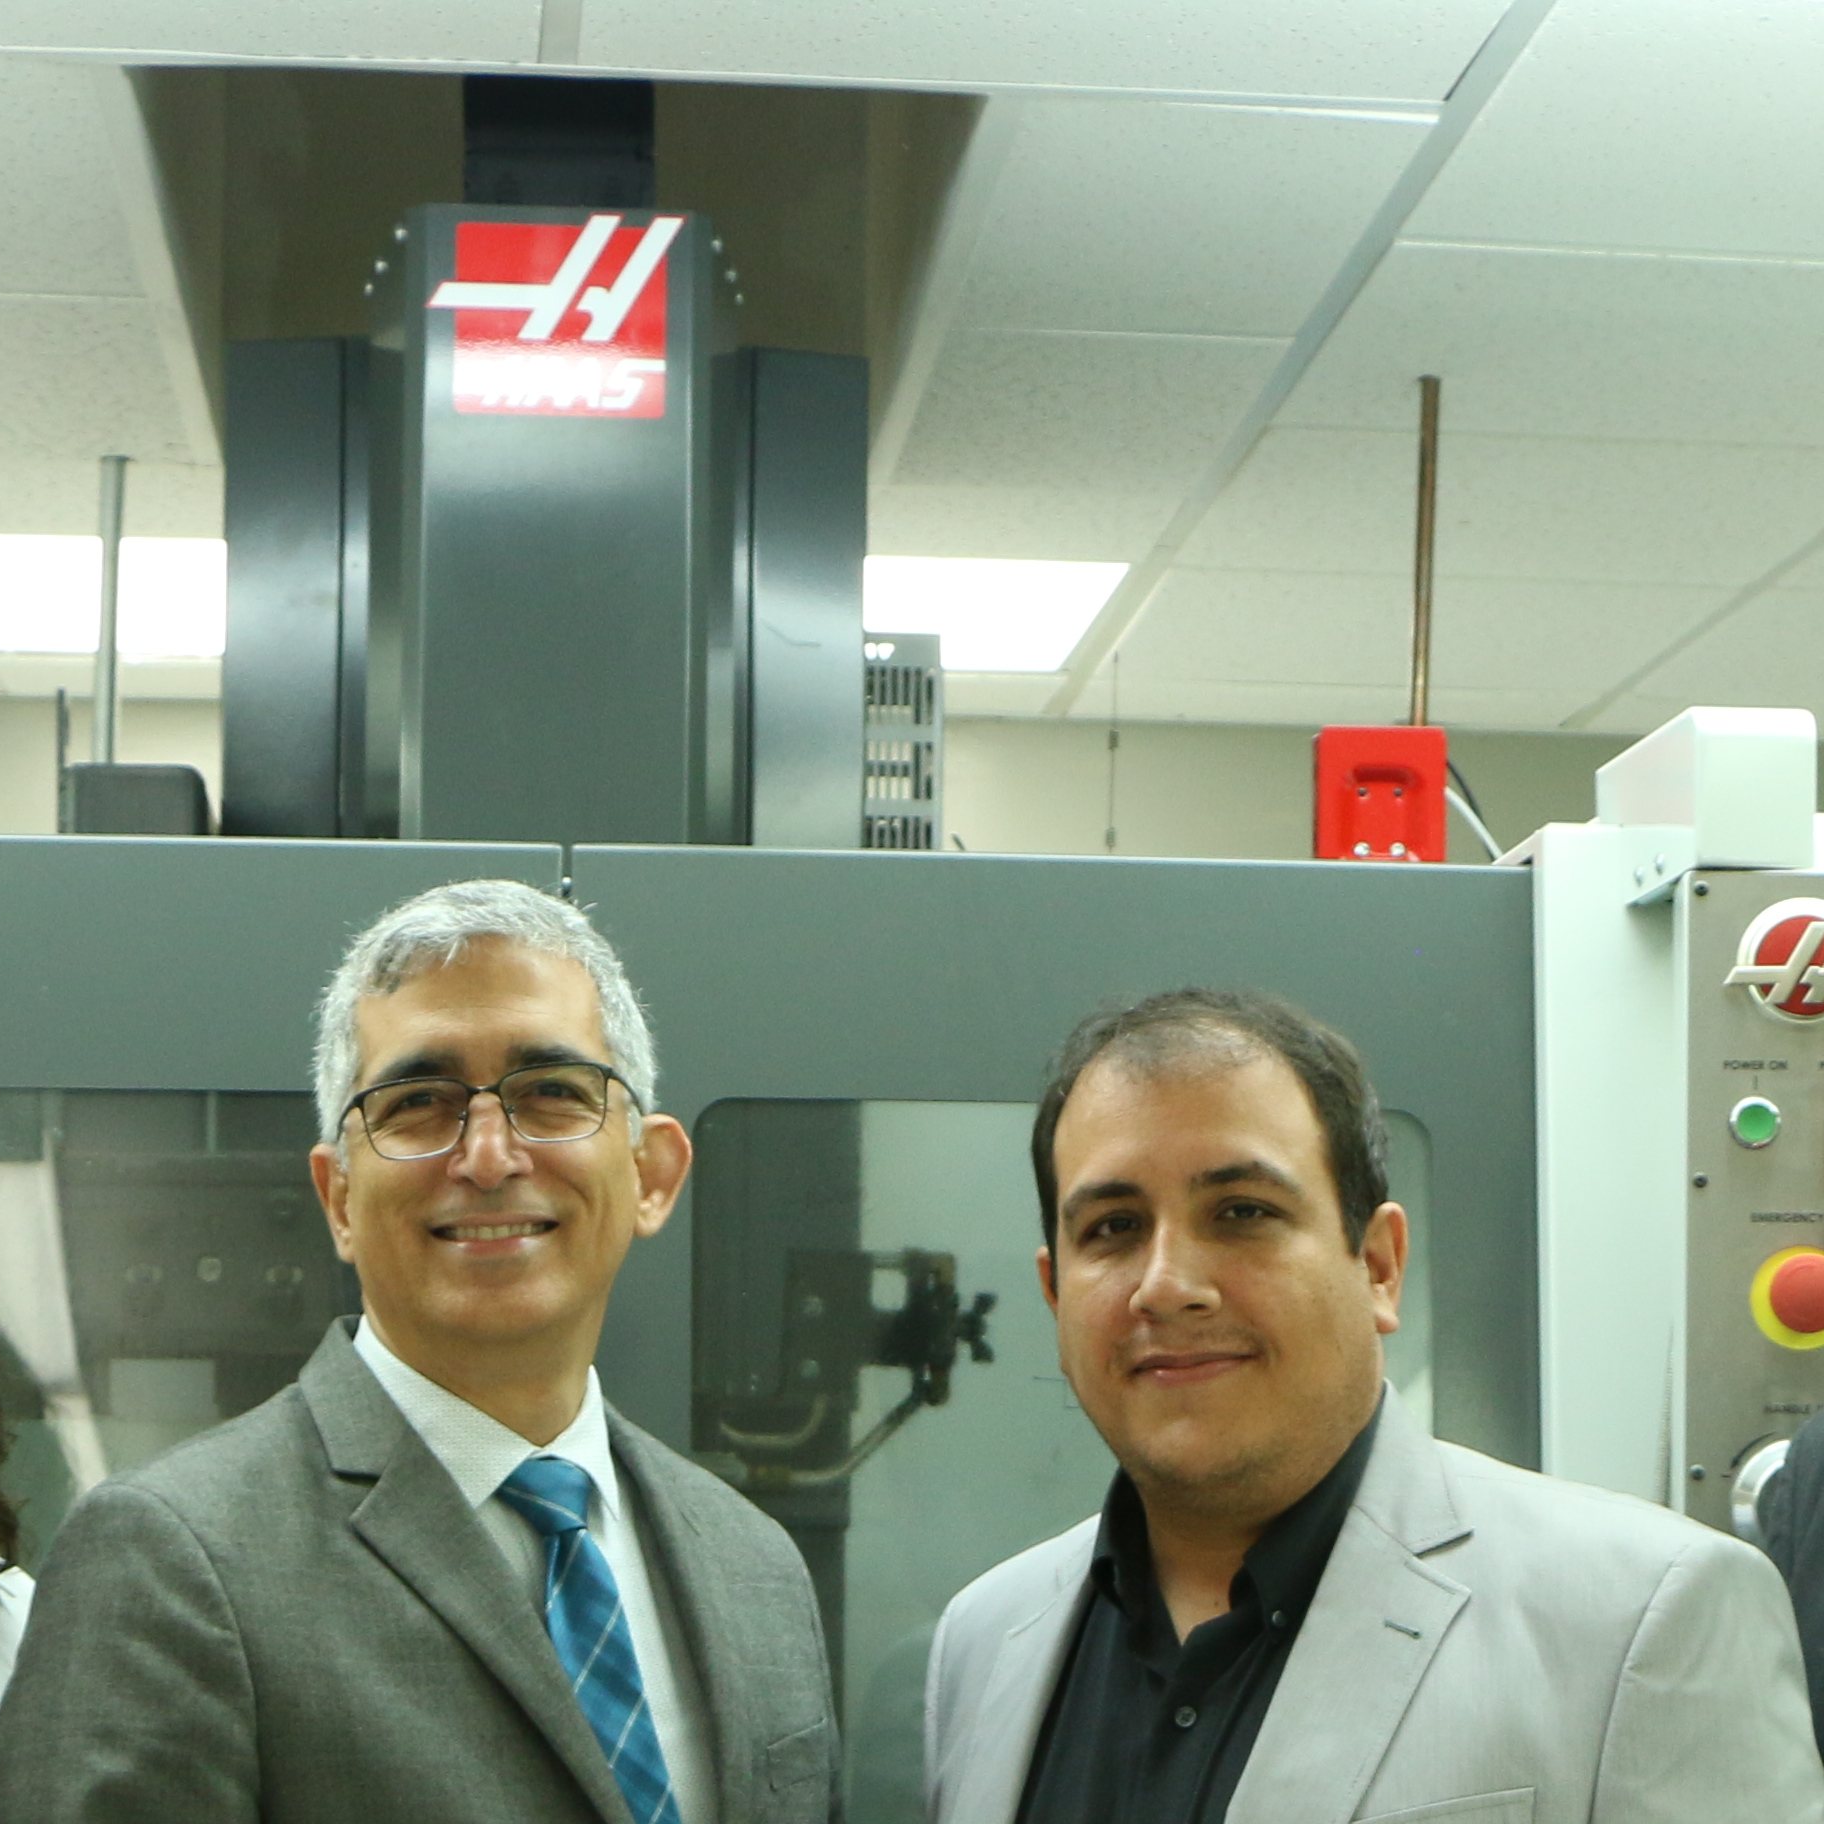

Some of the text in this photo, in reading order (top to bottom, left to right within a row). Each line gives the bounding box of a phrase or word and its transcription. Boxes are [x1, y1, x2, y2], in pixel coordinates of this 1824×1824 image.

[1723, 1059, 1788, 1070] POWER ON
[1750, 1212, 1824, 1222] EMERGENCY
